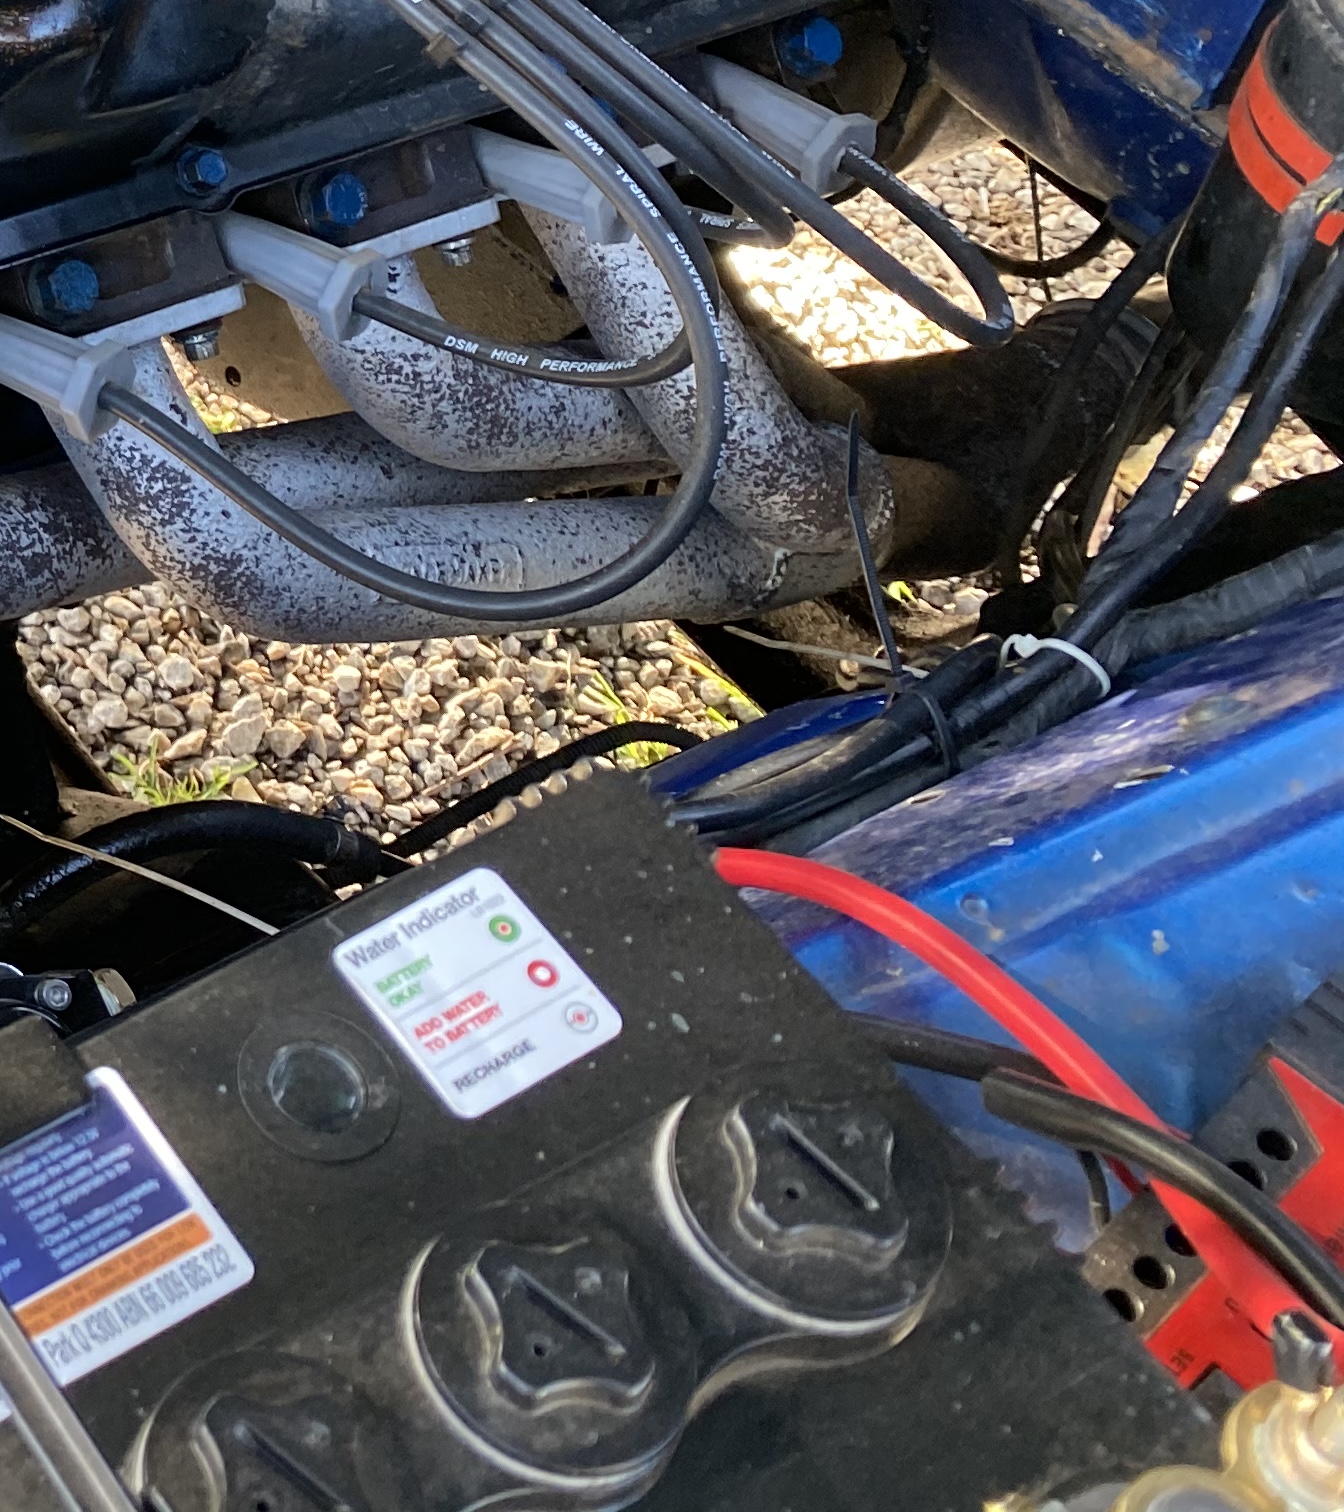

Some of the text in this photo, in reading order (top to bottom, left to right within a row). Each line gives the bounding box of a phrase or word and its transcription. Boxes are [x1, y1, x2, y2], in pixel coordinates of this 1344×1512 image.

[564, 119, 605, 156] WIRE
[615, 164, 662, 218] SPIRAL
[444, 336, 637, 373] DSM HIGH PERFORMANCE
[343, 931, 401, 969] Water
[399, 885, 480, 939] Indicator
[375, 953, 433, 995] BATTERY
[388, 980, 422, 1008] OKAY
[414, 990, 490, 1040] ADD WATER
[424, 1002, 503, 1054] TO BATTERY
[453, 1038, 536, 1093] RECHARGE
[42, 1327, 81, 1368] Park
[83, 1306, 123, 1345] 4300
